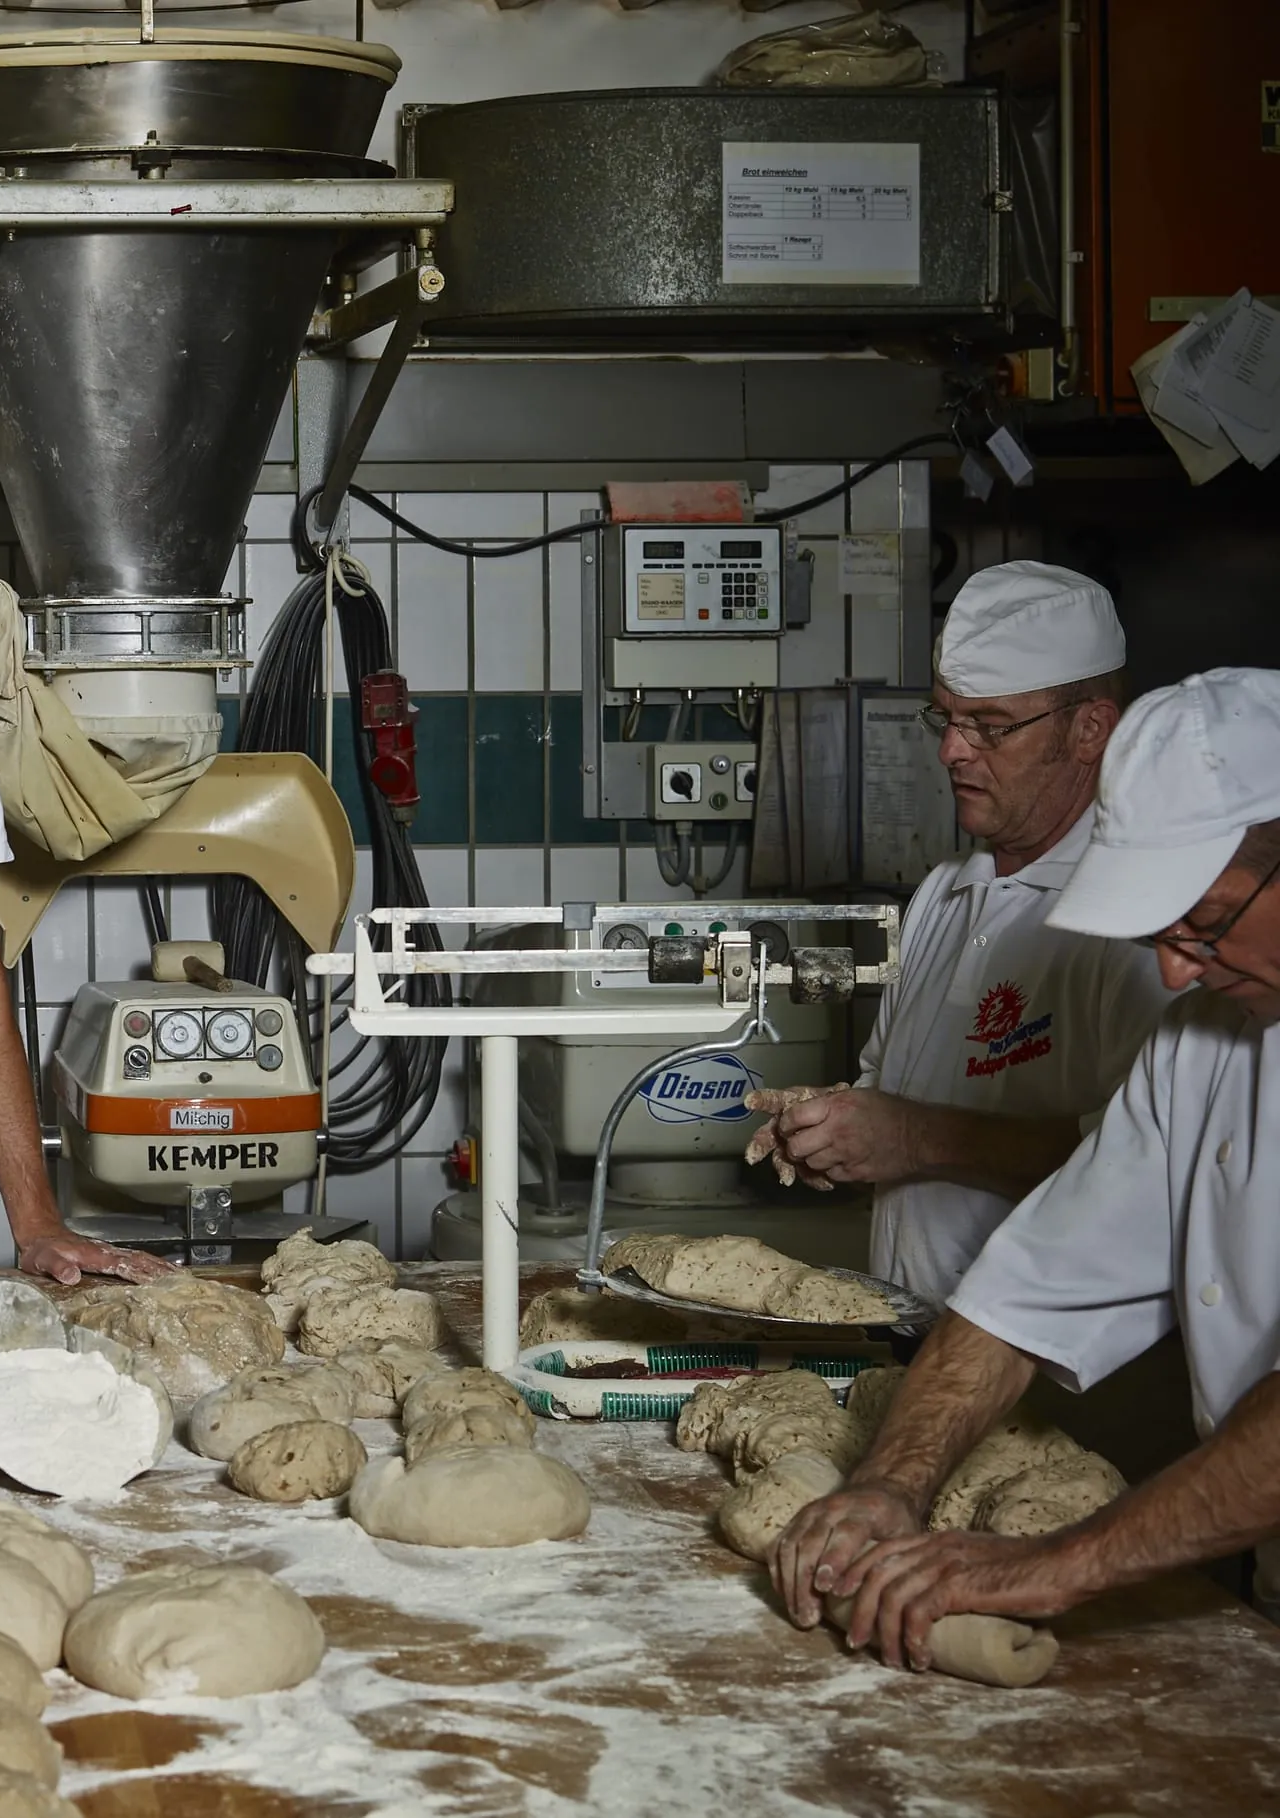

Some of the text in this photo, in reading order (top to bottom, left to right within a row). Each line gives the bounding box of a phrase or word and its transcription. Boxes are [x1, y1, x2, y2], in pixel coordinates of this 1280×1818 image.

[742, 168, 808, 178] Brot einweichen
[794, 187, 802, 195] kg
[657, 1073, 747, 1100] Diosna
[175, 1110, 231, 1129] Milchig
[148, 1142, 280, 1172] KEMPER
